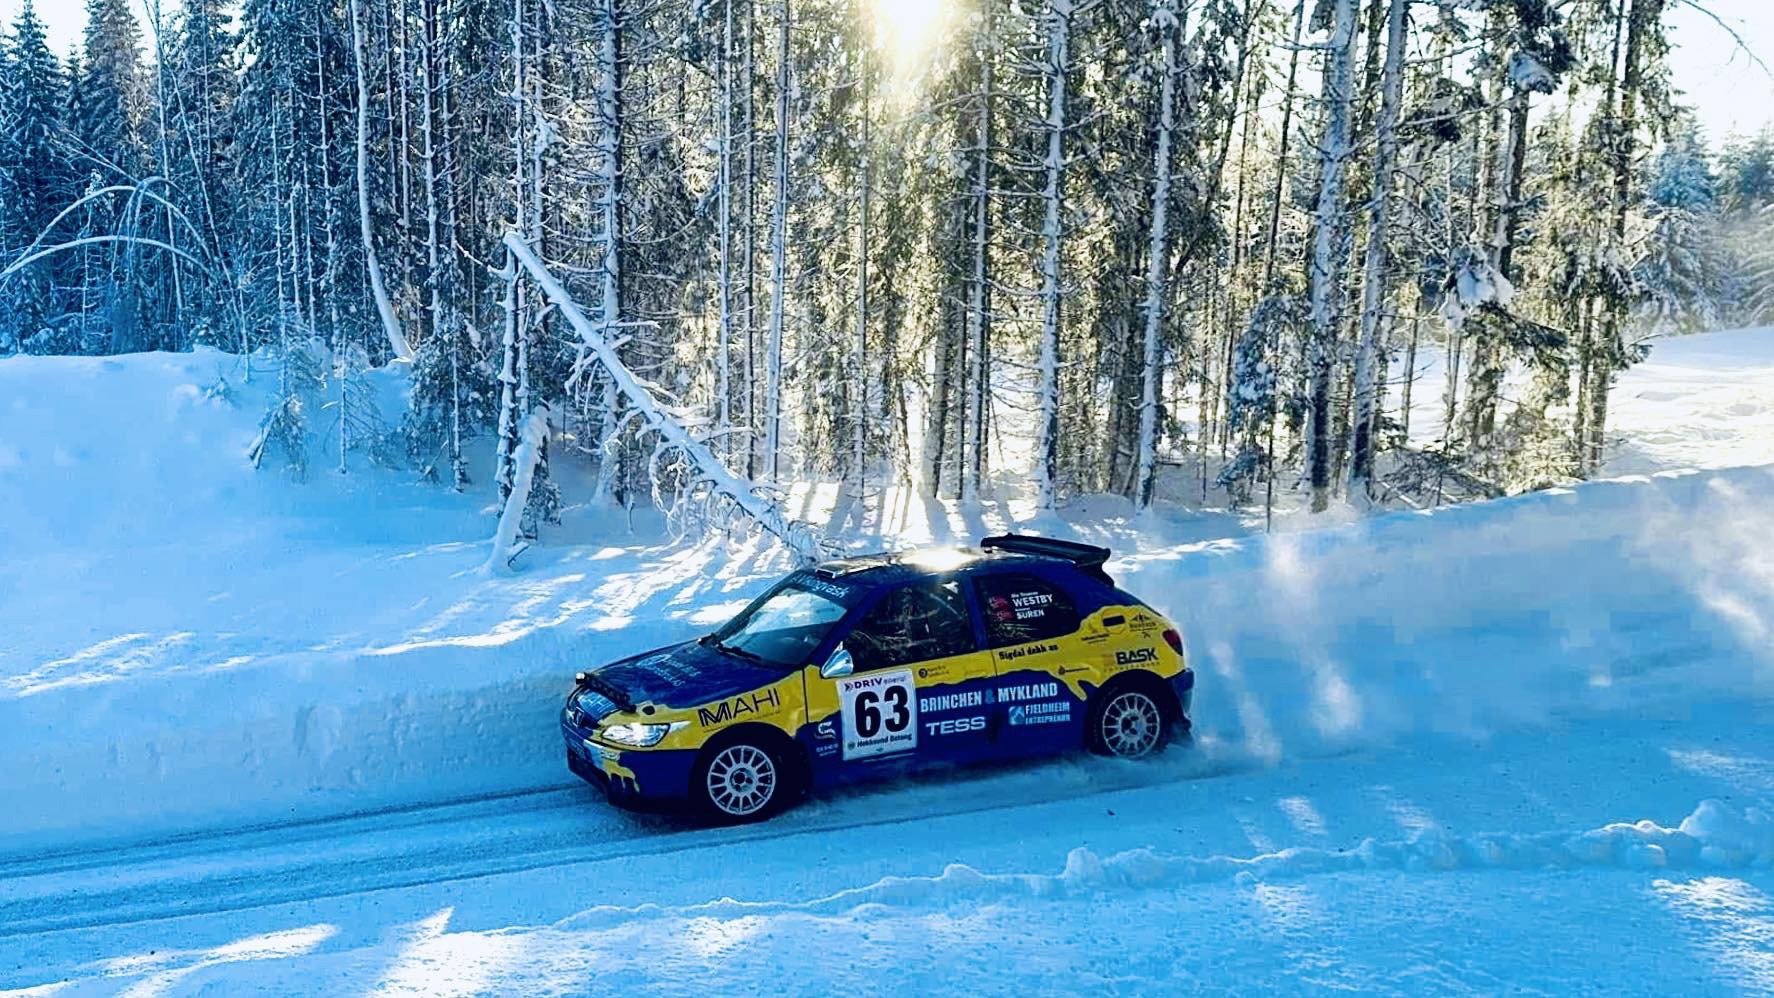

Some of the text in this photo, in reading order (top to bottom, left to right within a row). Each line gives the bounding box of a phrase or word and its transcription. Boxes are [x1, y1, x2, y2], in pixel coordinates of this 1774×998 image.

[1012, 594, 1053, 607] WESTBY
[998, 648, 1025, 660] Sigdal
[1115, 647, 1159, 665] BASK
[854, 677, 883, 689] DRIV
[920, 682, 1058, 713] BRINCHEN & MYKLAND
[697, 688, 781, 727] MAHI
[855, 685, 910, 738] 63
[1025, 701, 1070, 715] FJELDHEIM
[925, 716, 987, 737] TESS
